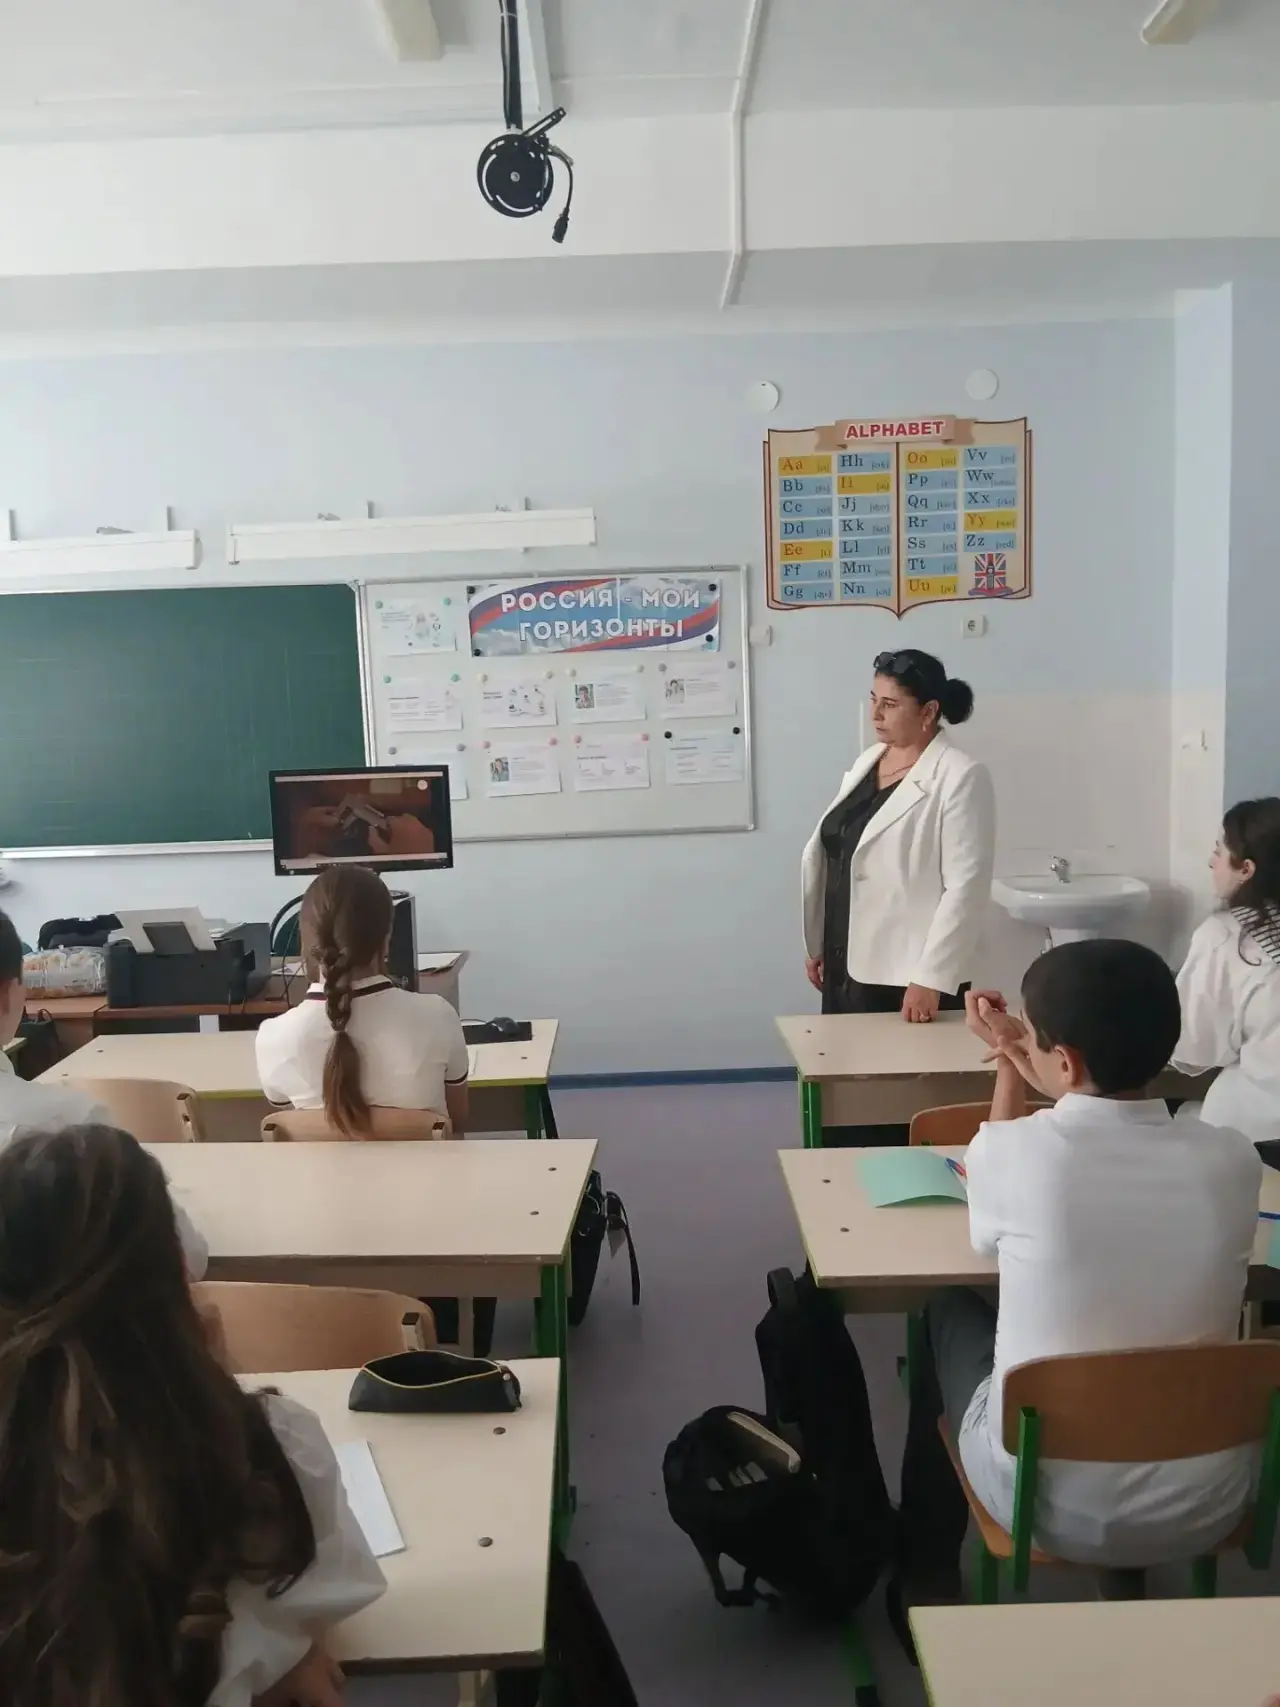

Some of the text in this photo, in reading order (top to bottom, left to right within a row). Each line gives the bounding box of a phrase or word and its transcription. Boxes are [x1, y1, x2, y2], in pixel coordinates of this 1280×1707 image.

[847, 421, 944, 439] ALPHABET
[501, 589, 613, 613] РОССИЯ
[641, 589, 701, 609] МОИ
[519, 619, 683, 641] ГОРИЗОНТЫ
